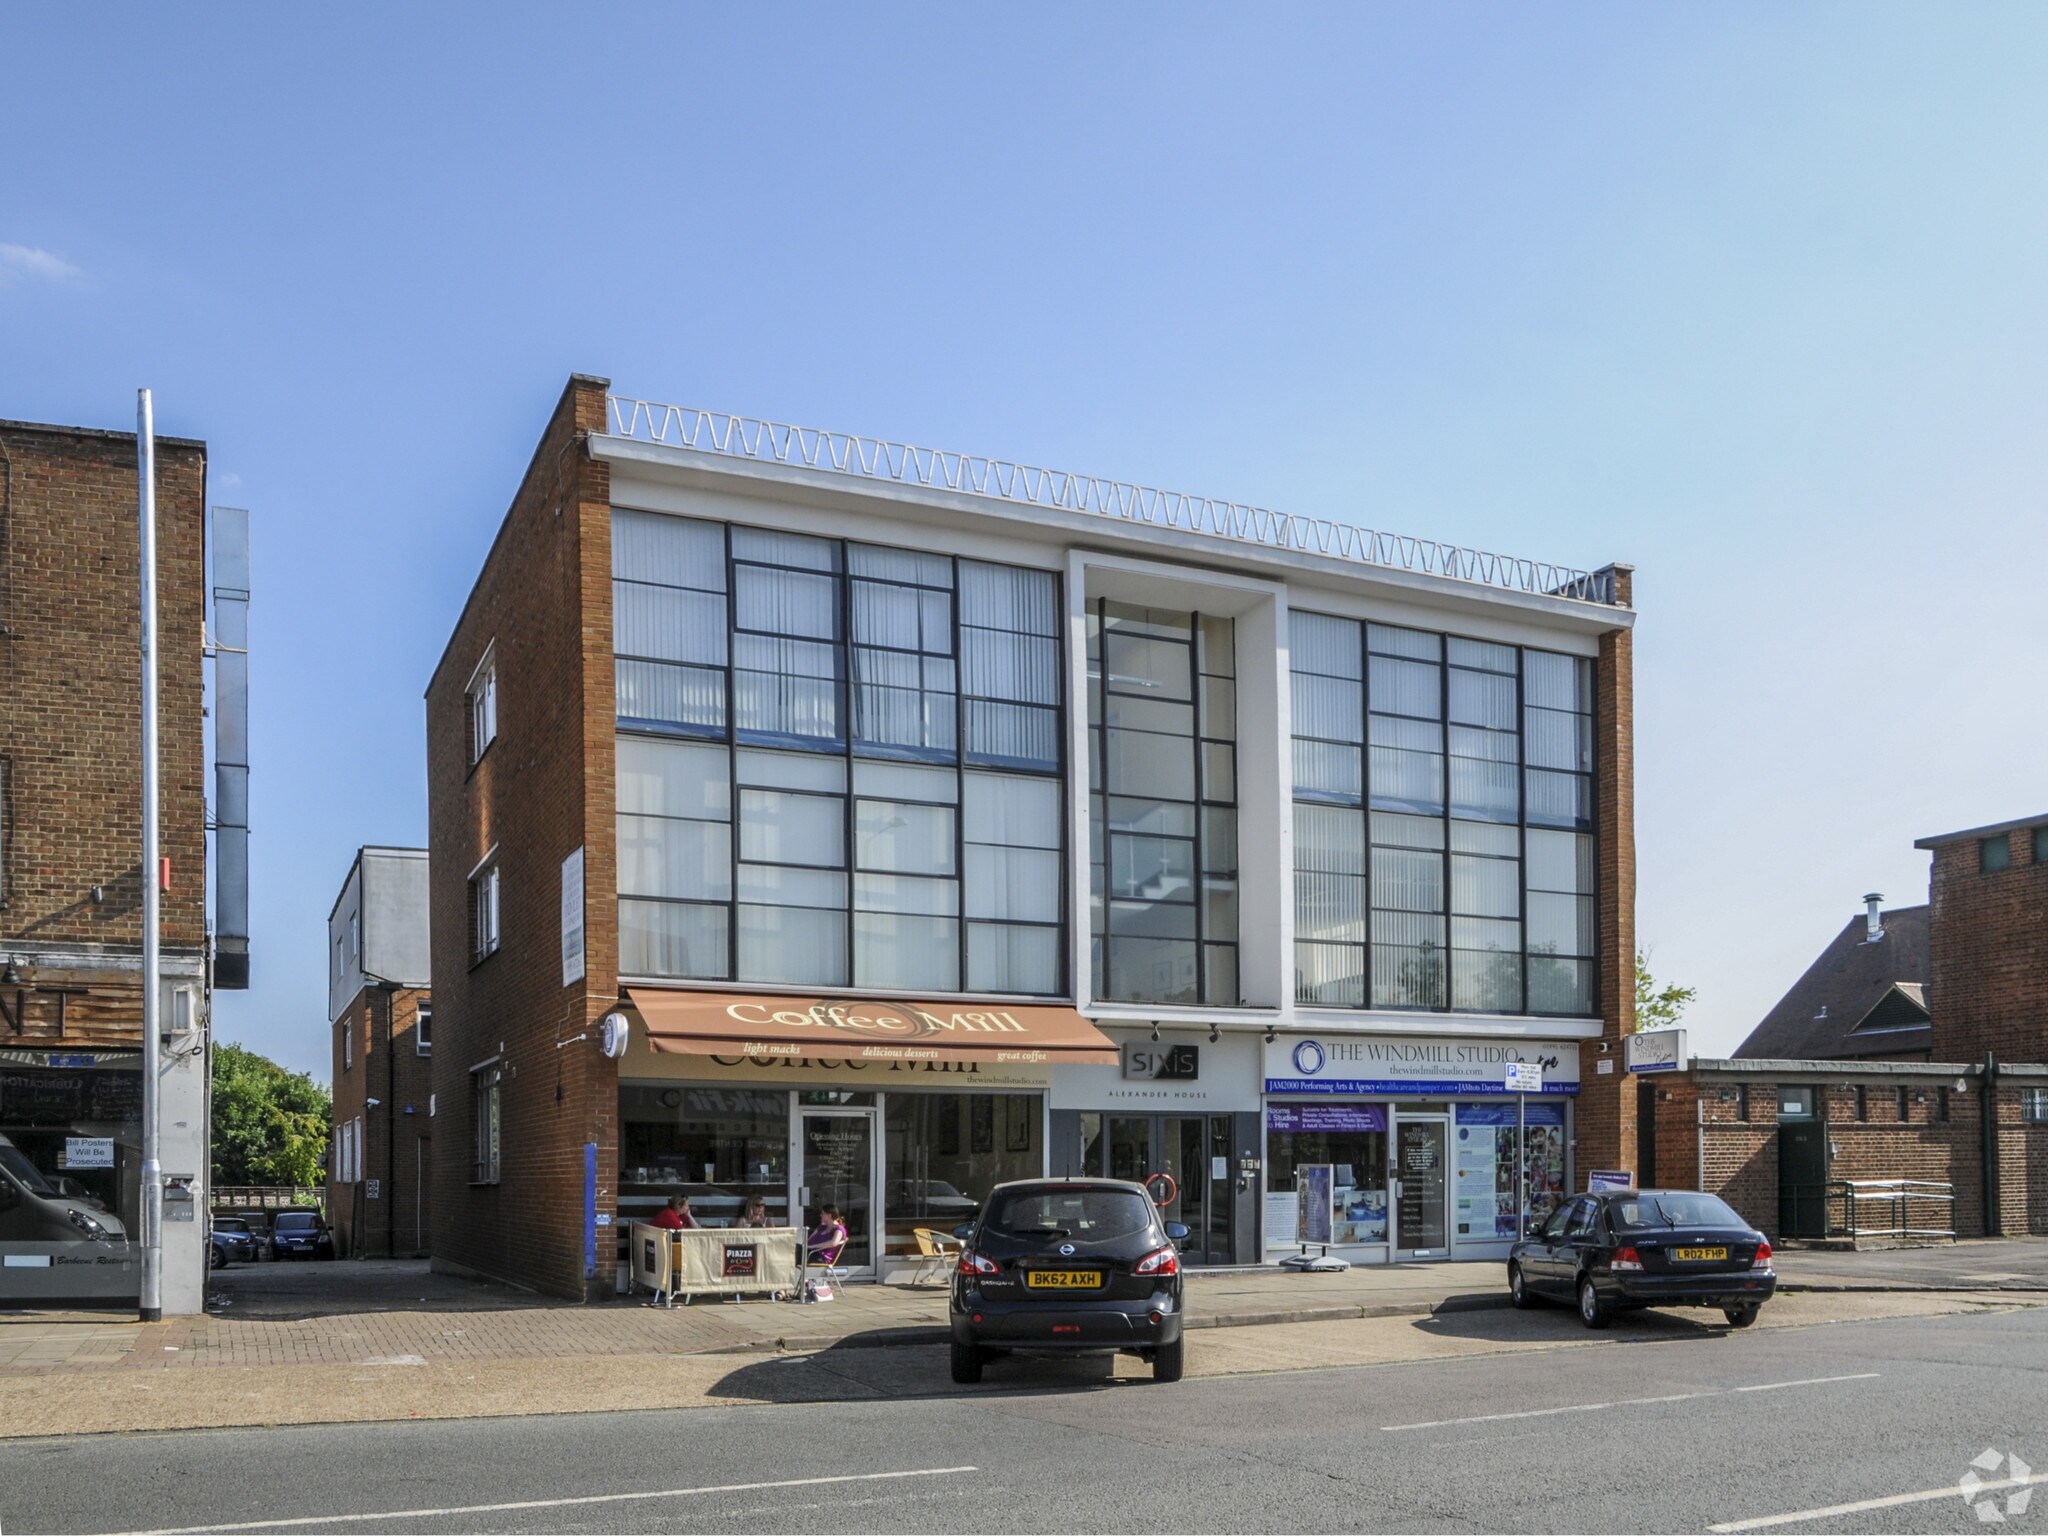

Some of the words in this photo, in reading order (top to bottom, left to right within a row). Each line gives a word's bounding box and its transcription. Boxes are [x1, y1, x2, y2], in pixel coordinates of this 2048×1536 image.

[726, 1003, 907, 1030] Coffee
[914, 1011, 1030, 1032] Mill
[743, 1042, 768, 1055] light
[769, 1044, 800, 1054] snacks
[862, 1047, 903, 1058] delicious
[904, 1048, 939, 1059] desserts
[1327, 1043, 1363, 1061] THE
[1368, 1044, 1454, 1063] WINDMILL
[1457, 1045, 1519, 1063] STUDIO
[997, 1051, 1020, 1062] great
[1022, 1050, 1047, 1062] coffee
[1389, 1064, 1483, 1076] thewindmillstudio.com
[966, 1075, 1048, 1085] thewindmillstudio.com
[1269, 1081, 1299, 1091] JAM2000
[1300, 1081, 1334, 1093] Performing
[1335, 1082, 1348, 1090] Arts
[1348, 1082, 1354, 1090] &
[1355, 1082, 1376, 1093] Agency
[1481, 1083, 1504, 1094] Daytime
[1108, 1091, 1168, 1099] ALEXANDER
[1273, 1114, 1299, 1122] Studios
[1274, 1121, 1289, 1129] Hire
[809, 1131, 838, 1142] Opening
[841, 1131, 863, 1141] Hours
[81, 1139, 113, 1147] Posters
[75, 1148, 90, 1156] Will
[92, 1148, 105, 1156] Be
[726, 1249, 753, 1258] PIAZZA
[1677, 1249, 1703, 1260] LR02
[1706, 1249, 1725, 1259] FHP
[1034, 1273, 1067, 1285] BK62
[1070, 1273, 1096, 1285] AXH
